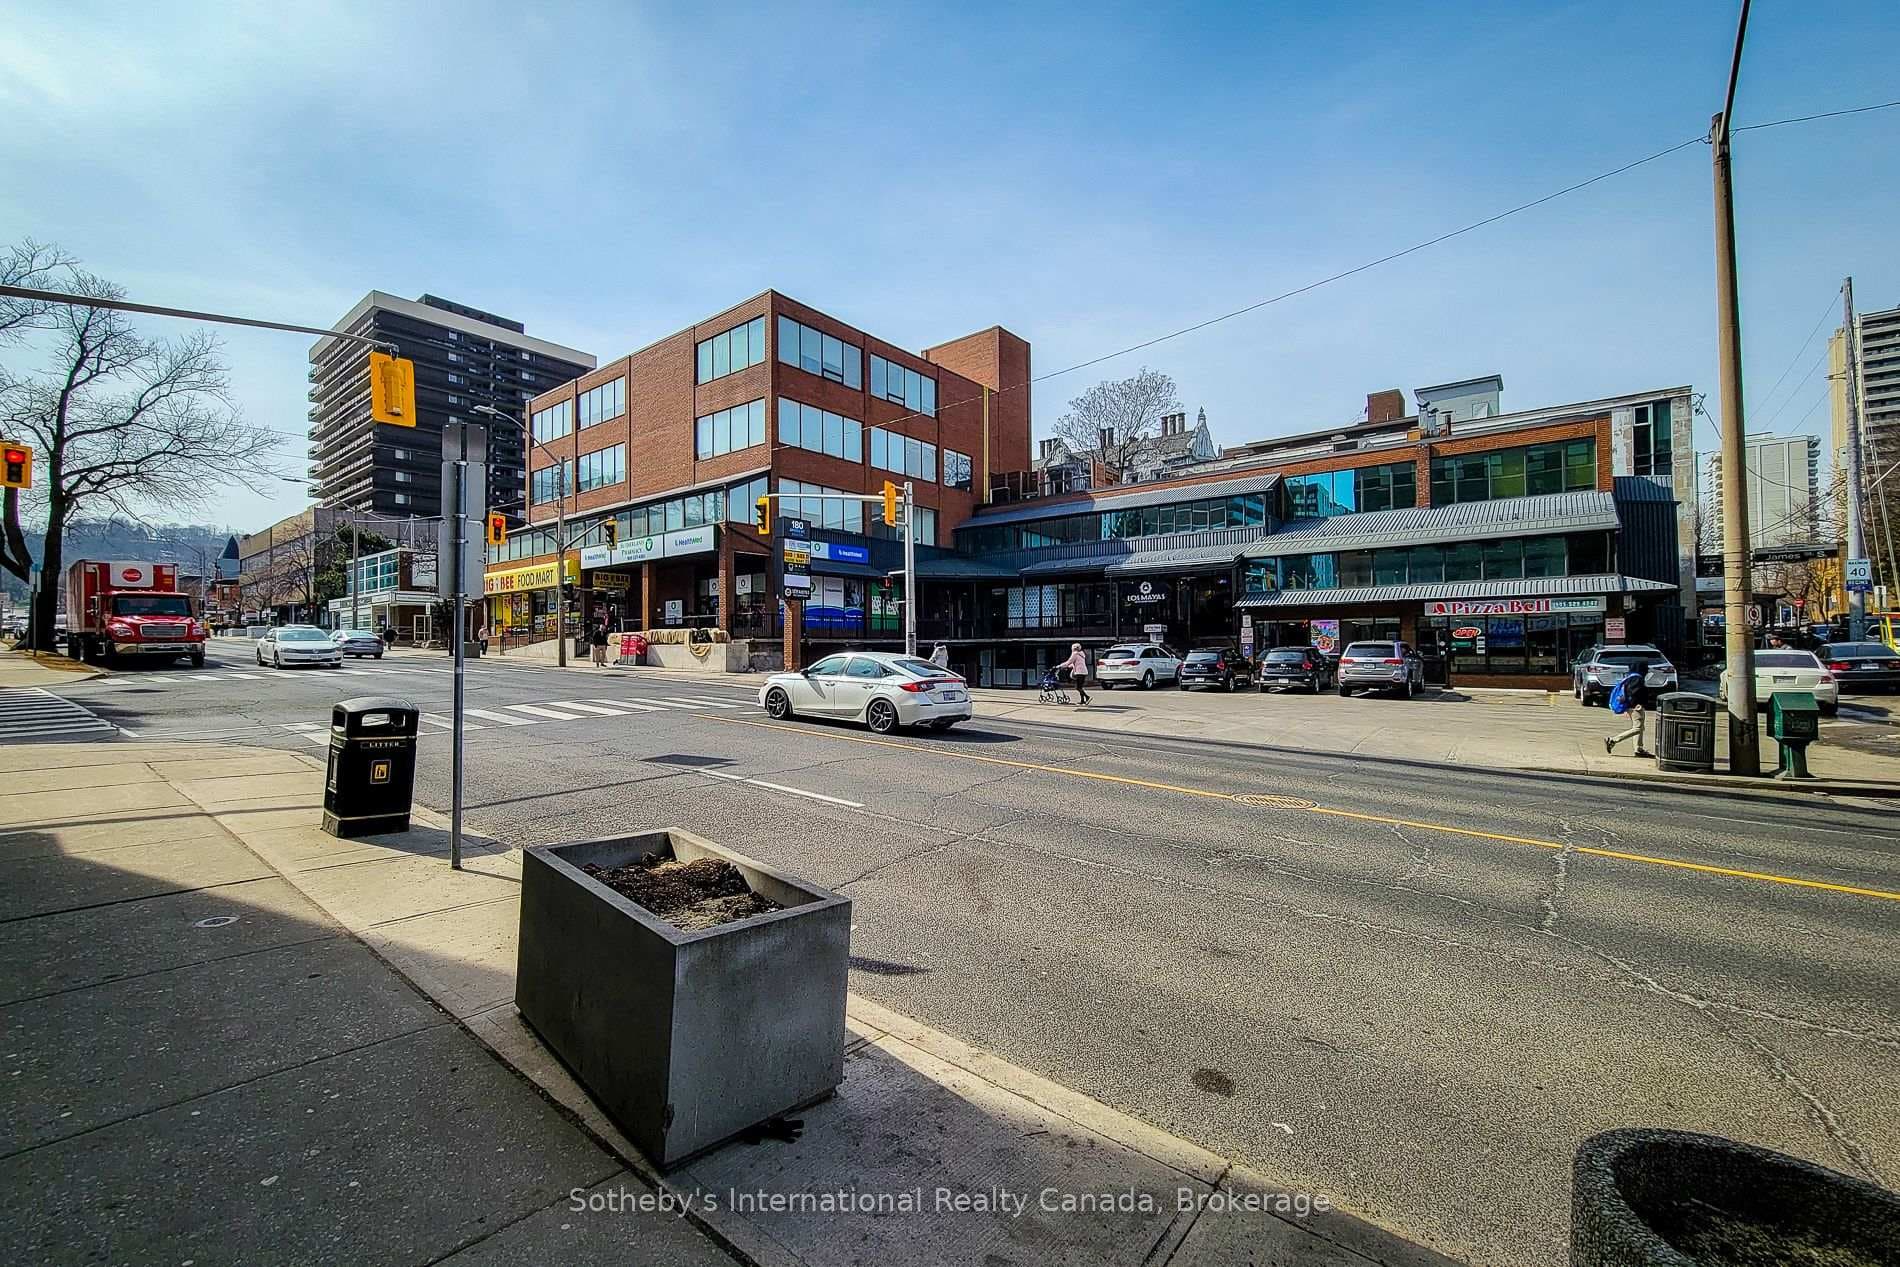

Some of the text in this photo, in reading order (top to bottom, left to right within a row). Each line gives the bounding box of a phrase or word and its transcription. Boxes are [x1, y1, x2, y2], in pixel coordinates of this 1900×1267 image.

[792, 520, 804, 529] 180
[1767, 552, 1801, 561] James
[1816, 550, 1826, 558] S
[1850, 567, 1867, 577] 40
[485, 568, 554, 592] IG BEE FOOD MART
[1452, 598, 1550, 615] Pizza Bell
[1455, 629, 1478, 637] OPEN
[369, 741, 399, 749] LITTER
